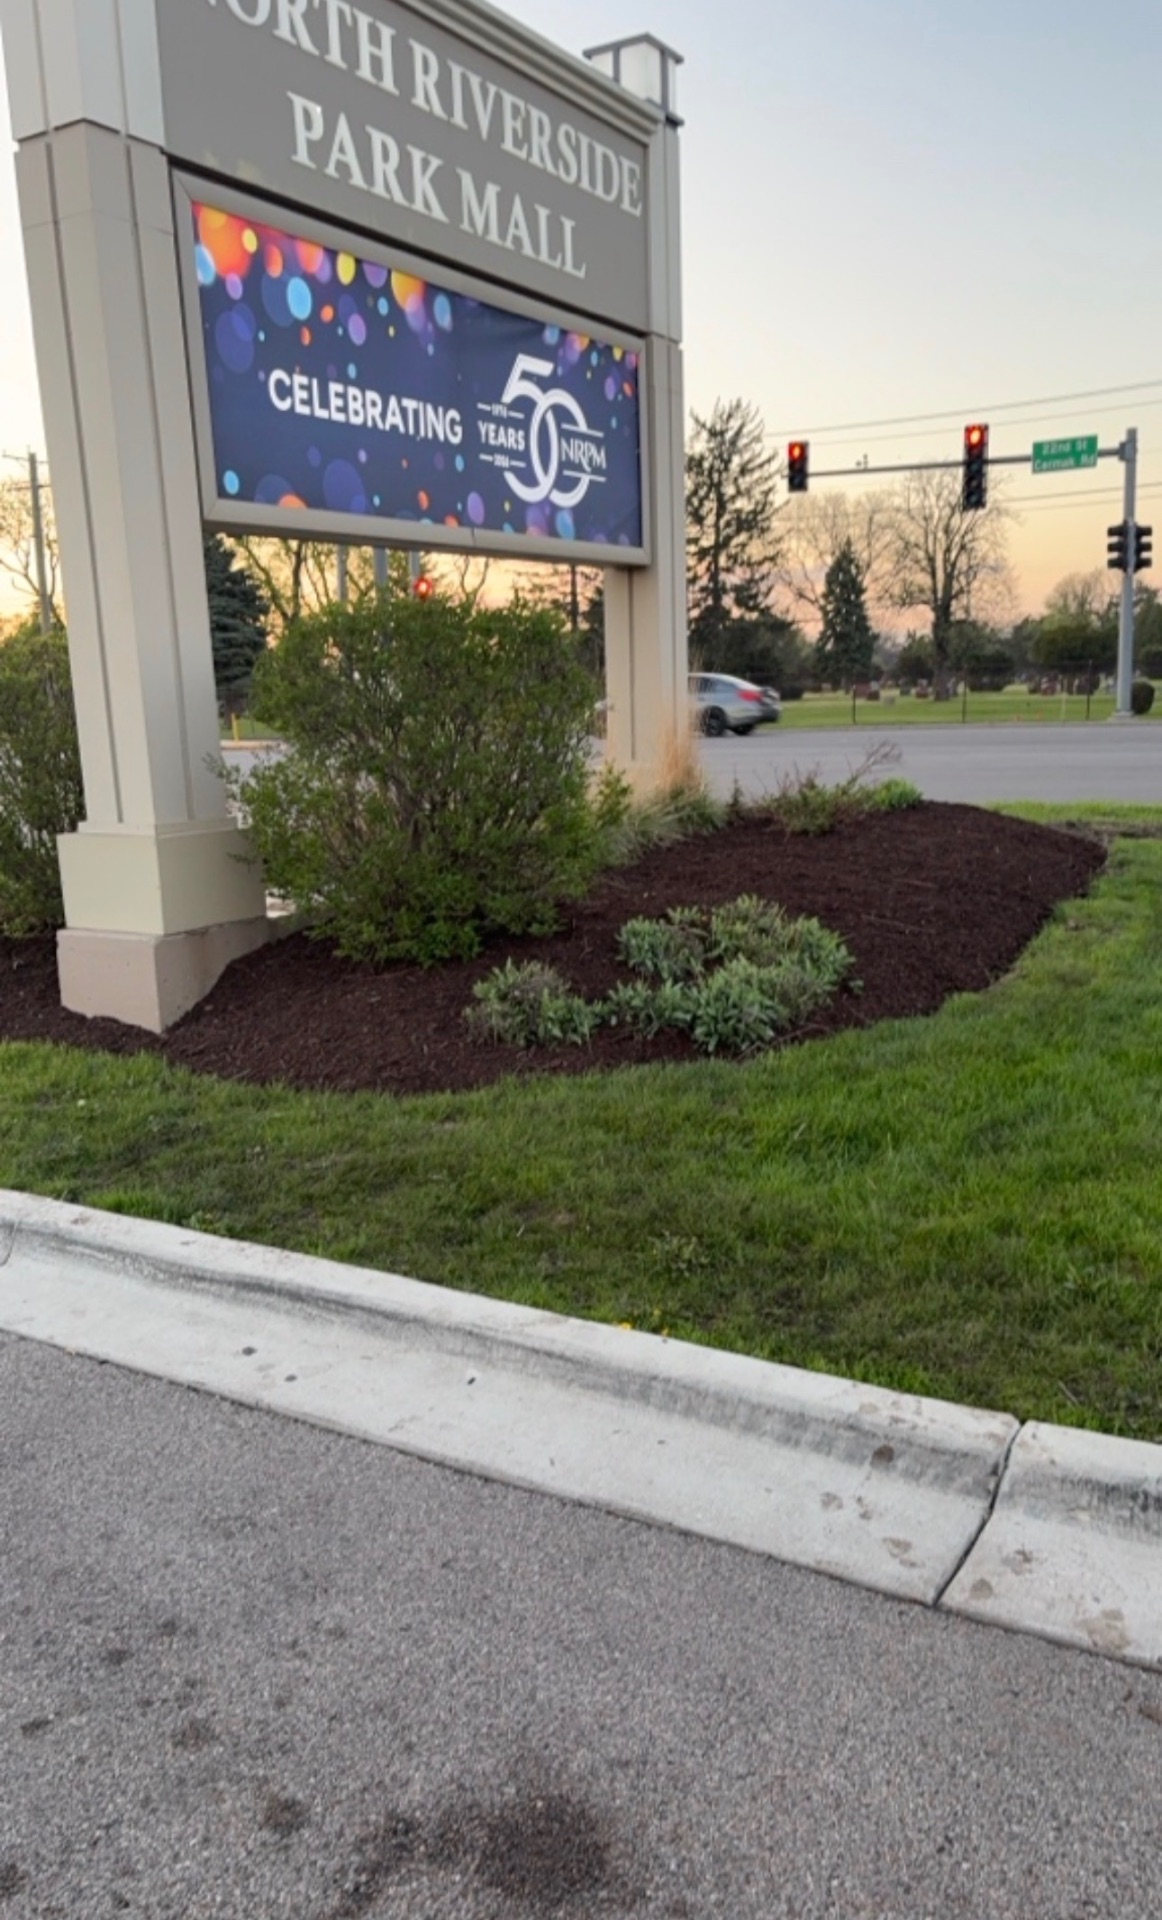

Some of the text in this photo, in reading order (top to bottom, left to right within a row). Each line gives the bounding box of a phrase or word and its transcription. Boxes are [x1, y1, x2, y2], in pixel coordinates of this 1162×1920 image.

[208, 0, 643, 217] RTH RIVERSIDE
[286, 90, 587, 280] PARK MALL
[268, 368, 463, 445] CELEBRATING
[477, 420, 526, 451] YEARS
[1042, 441, 1071, 455] 22nd
[560, 437, 607, 473] NRPM
[1034, 456, 1075, 470] Cermak
